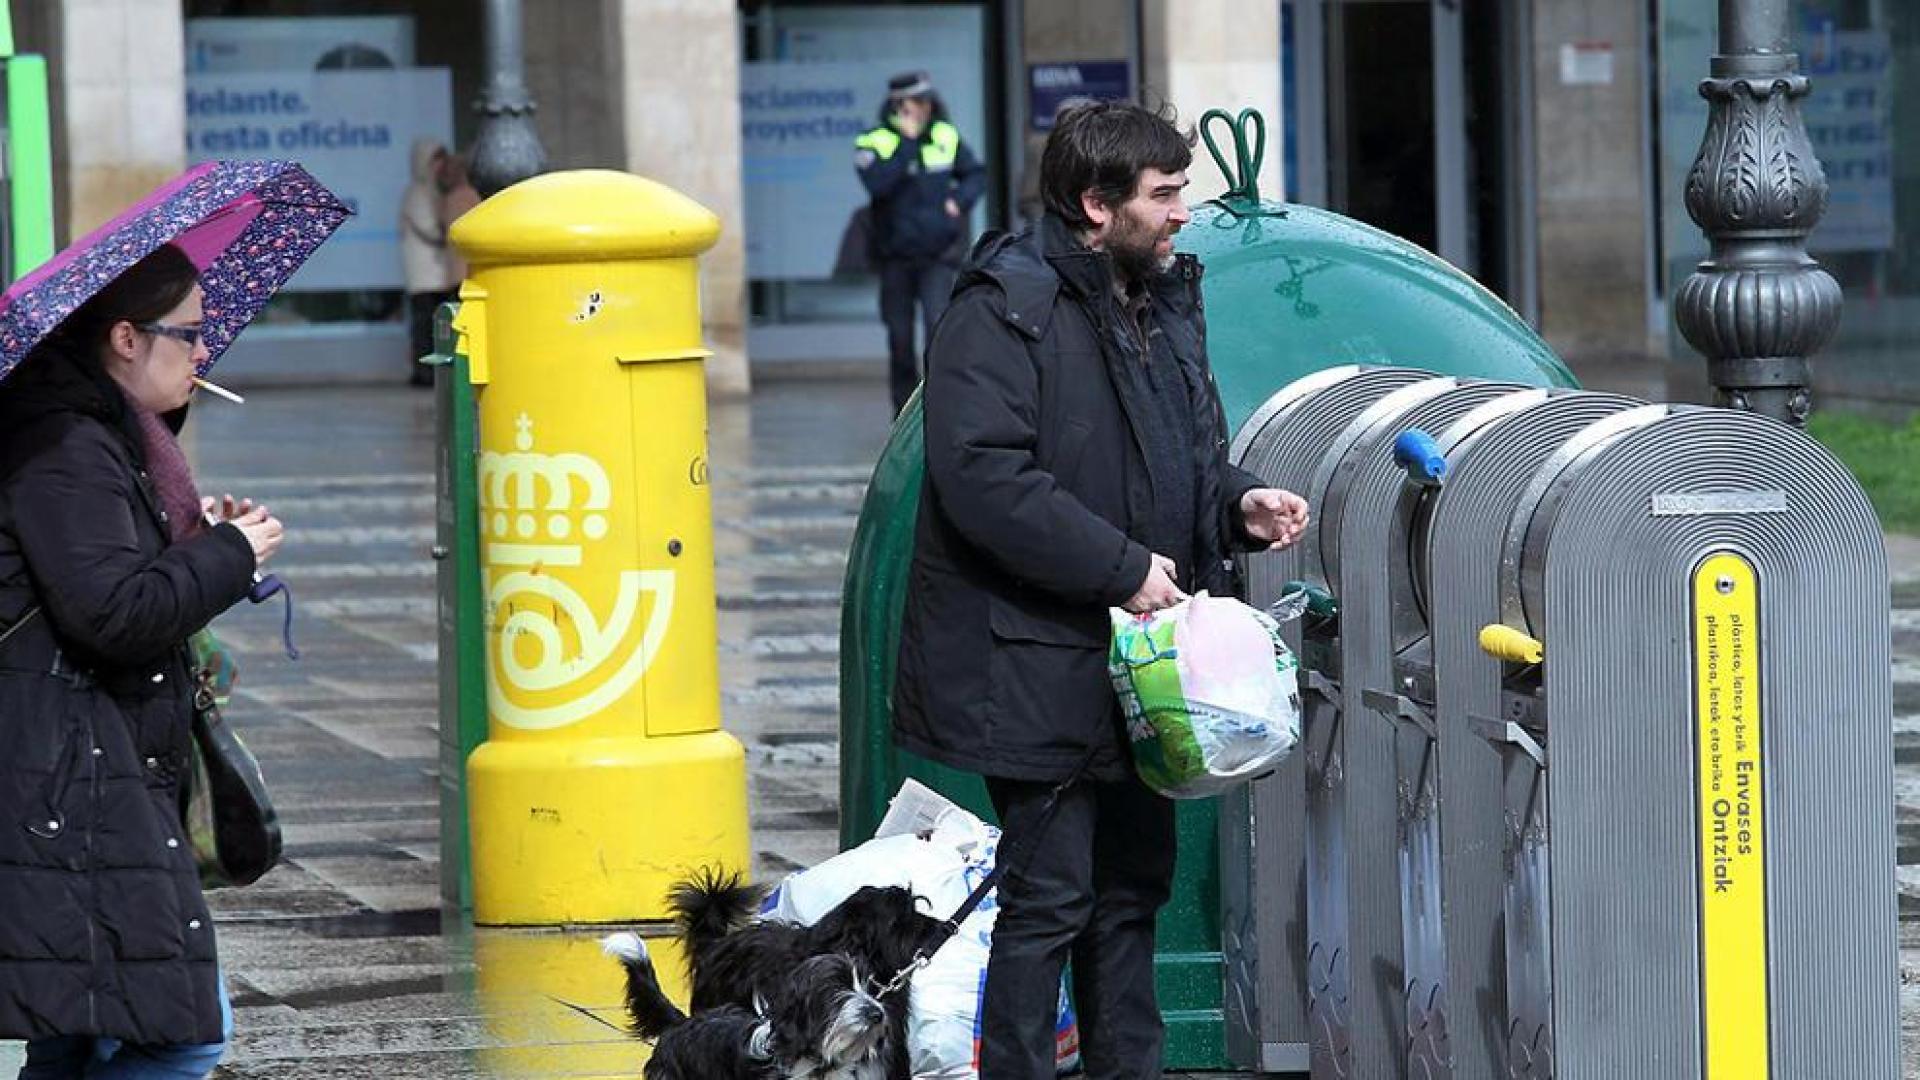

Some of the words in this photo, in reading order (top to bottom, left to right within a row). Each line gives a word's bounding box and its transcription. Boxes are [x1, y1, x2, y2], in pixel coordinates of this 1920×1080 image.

[203, 126, 270, 149] esta
[277, 121, 391, 147] oficina
[1733, 676, 1745, 711] latas
[1731, 713, 1743, 724] y
[1736, 760, 1753, 855] Envases
[1712, 798, 1733, 893] Ontziak
